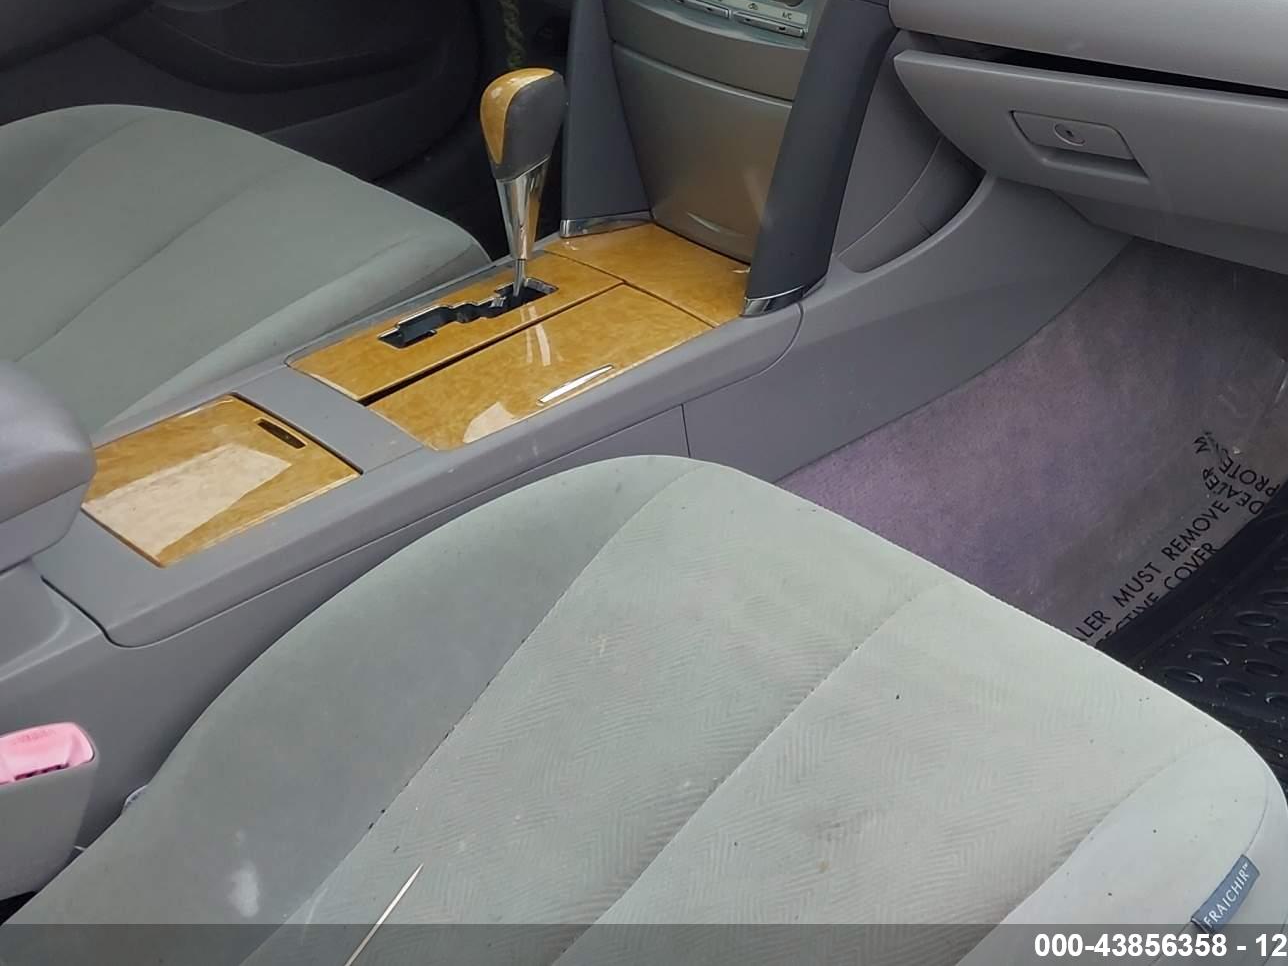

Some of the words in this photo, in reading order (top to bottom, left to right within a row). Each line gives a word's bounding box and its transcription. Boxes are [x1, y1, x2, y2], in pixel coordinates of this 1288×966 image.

[782, 11, 792, 20] A/C
[1203, 467, 1265, 515] DEALER
[1076, 610, 1111, 641] LER
[1112, 561, 1163, 608] MUST
[1161, 500, 1230, 561] REMOVE
[1163, 541, 1219, 591] COVER
